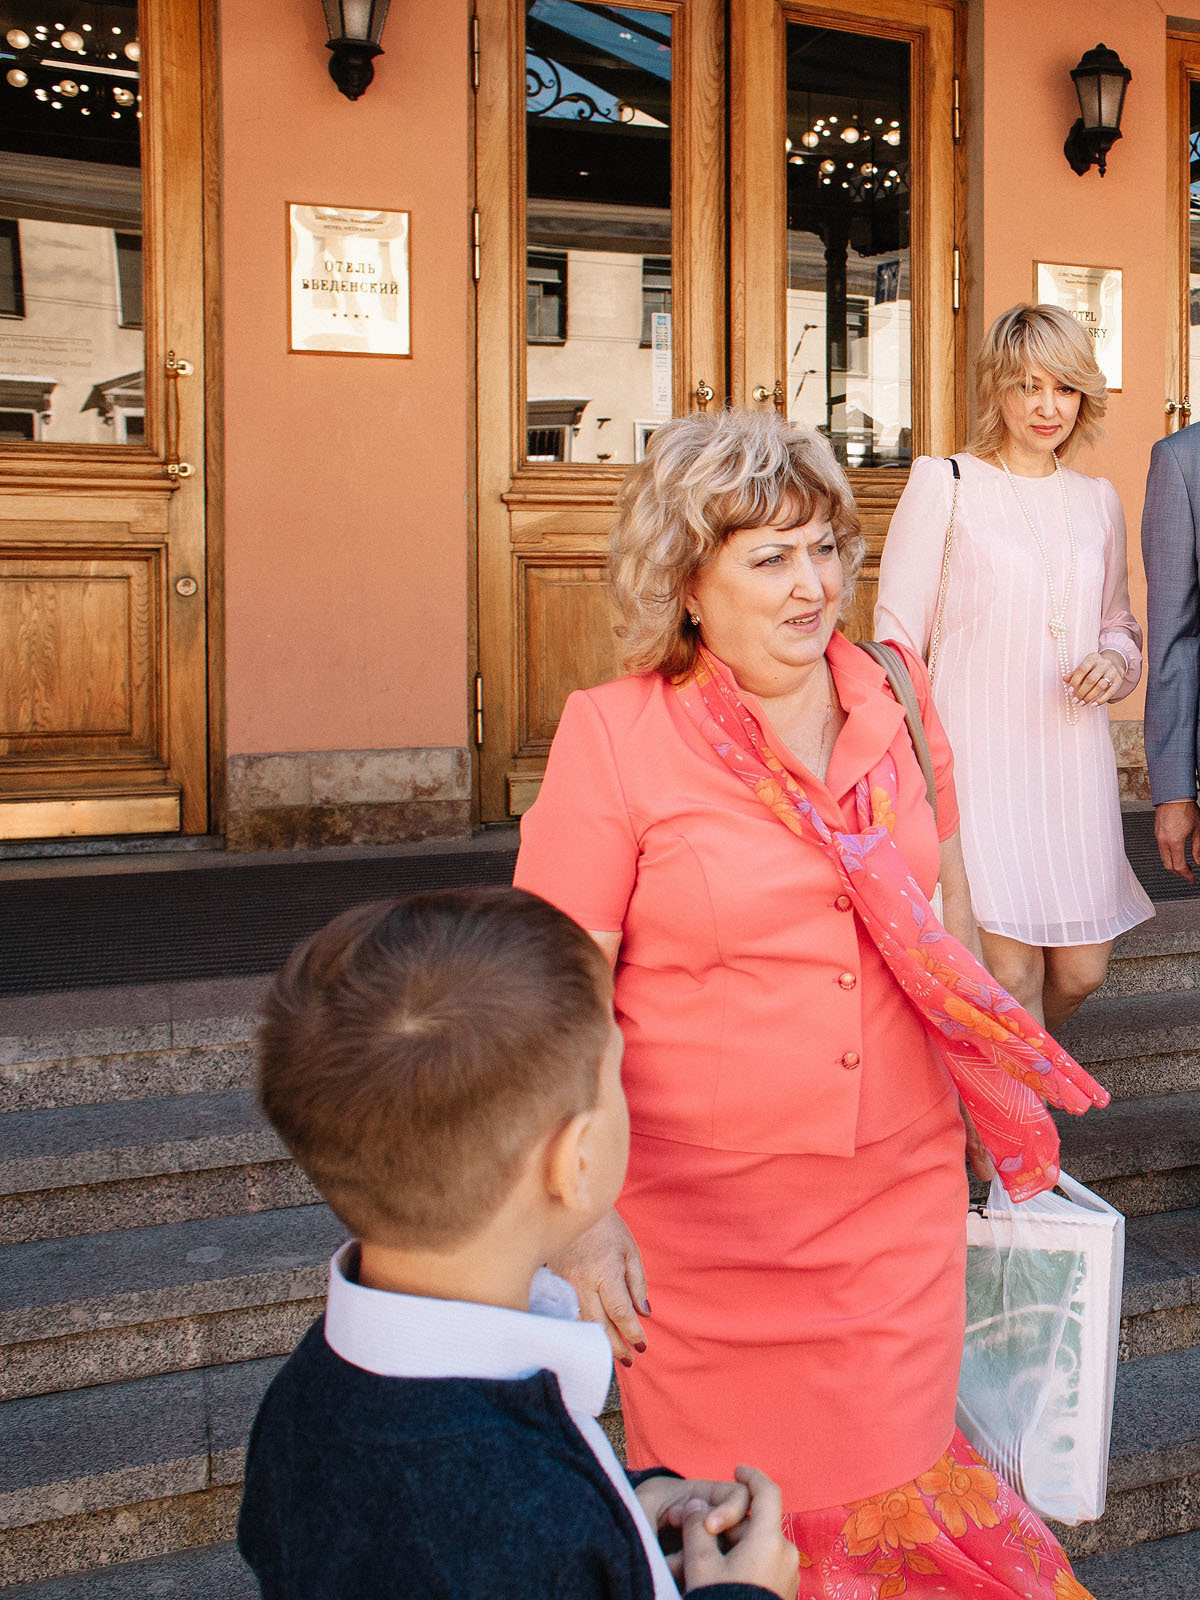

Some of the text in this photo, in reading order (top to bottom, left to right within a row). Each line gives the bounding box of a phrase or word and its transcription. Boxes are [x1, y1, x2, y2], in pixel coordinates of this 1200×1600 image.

[324, 260, 376, 274] ОТЕЛЬ
[301, 278, 399, 295] ВВЕДЕНСКИЙ
[1069, 310, 1097, 322] OTEL
